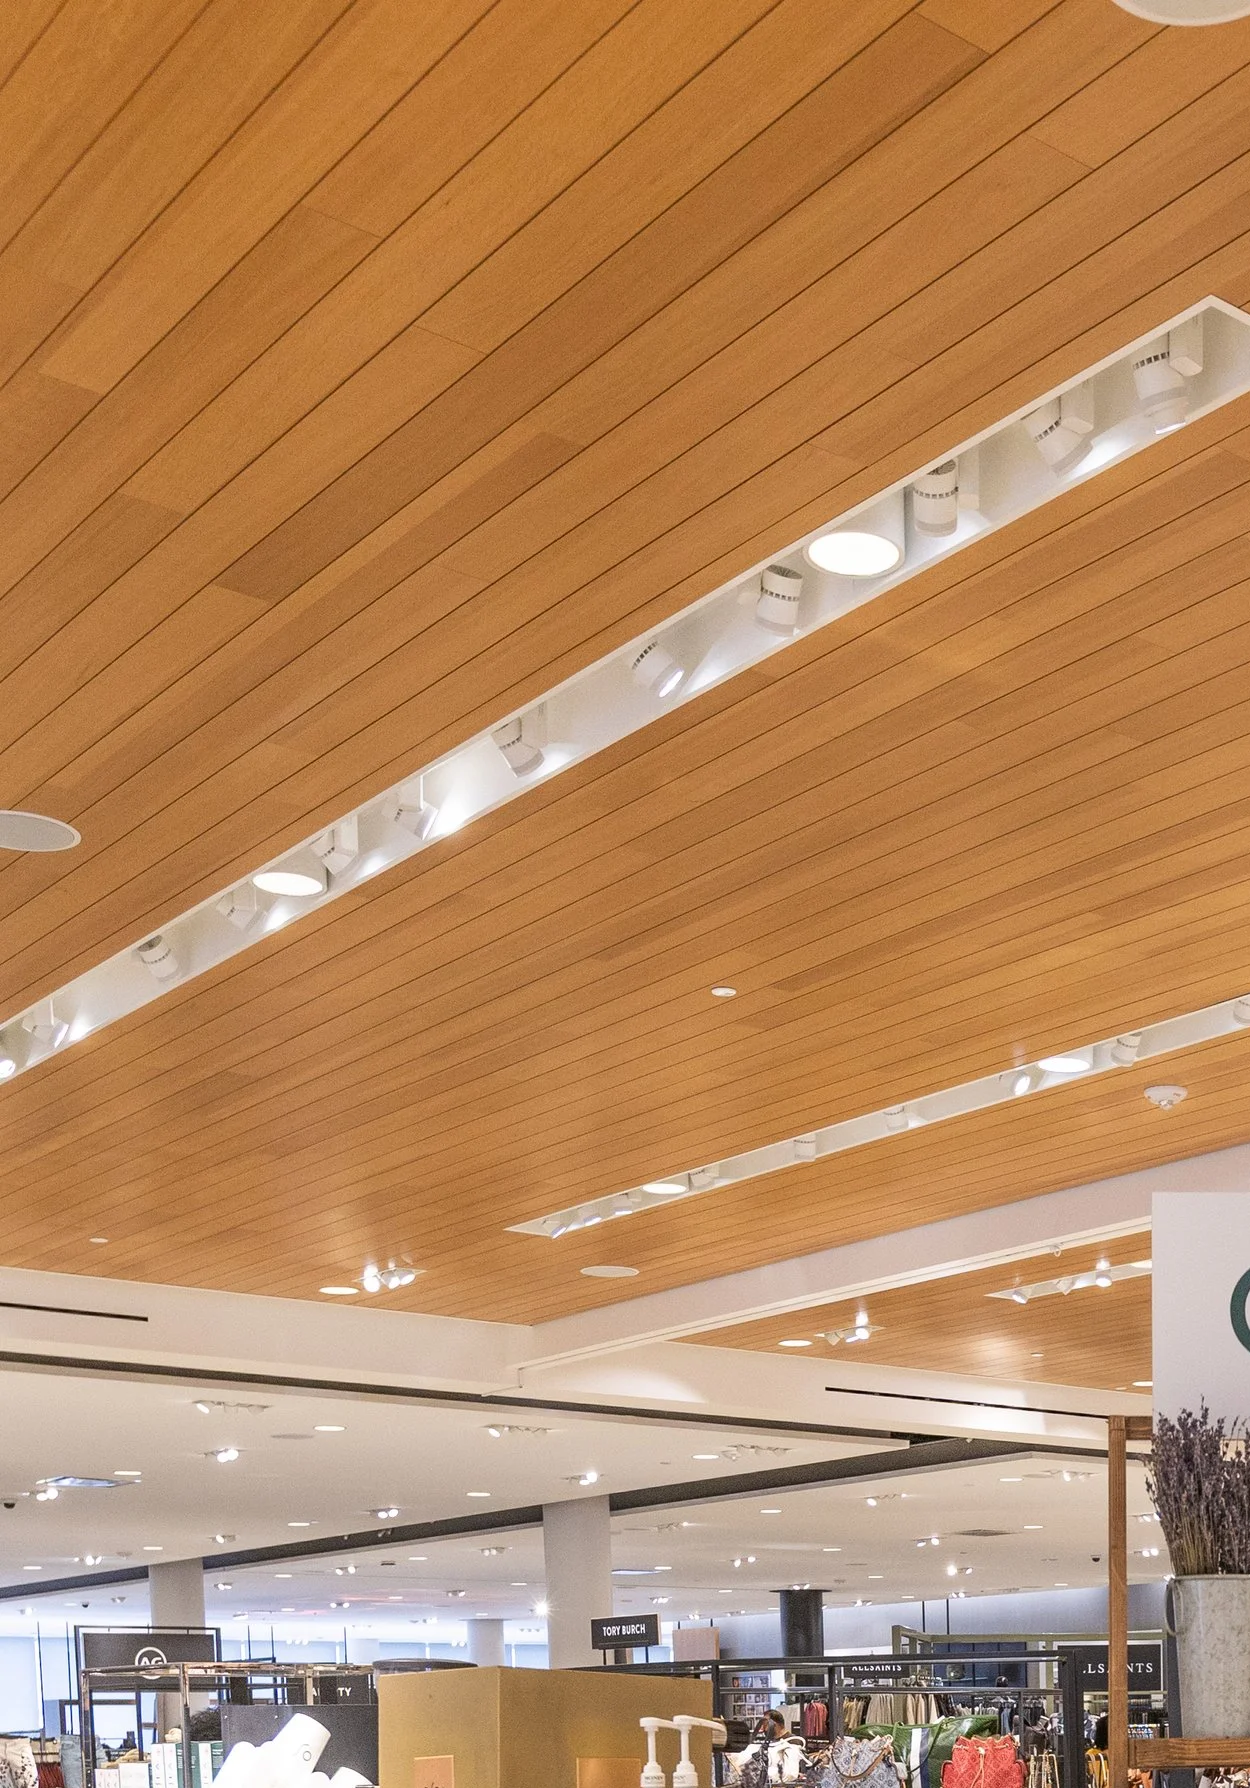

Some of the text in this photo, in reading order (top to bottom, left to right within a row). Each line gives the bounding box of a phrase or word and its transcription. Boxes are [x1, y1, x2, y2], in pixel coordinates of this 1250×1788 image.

[602, 1623, 646, 1637] TORY BURCH
[851, 1662, 903, 1672] ALLSAINTS
